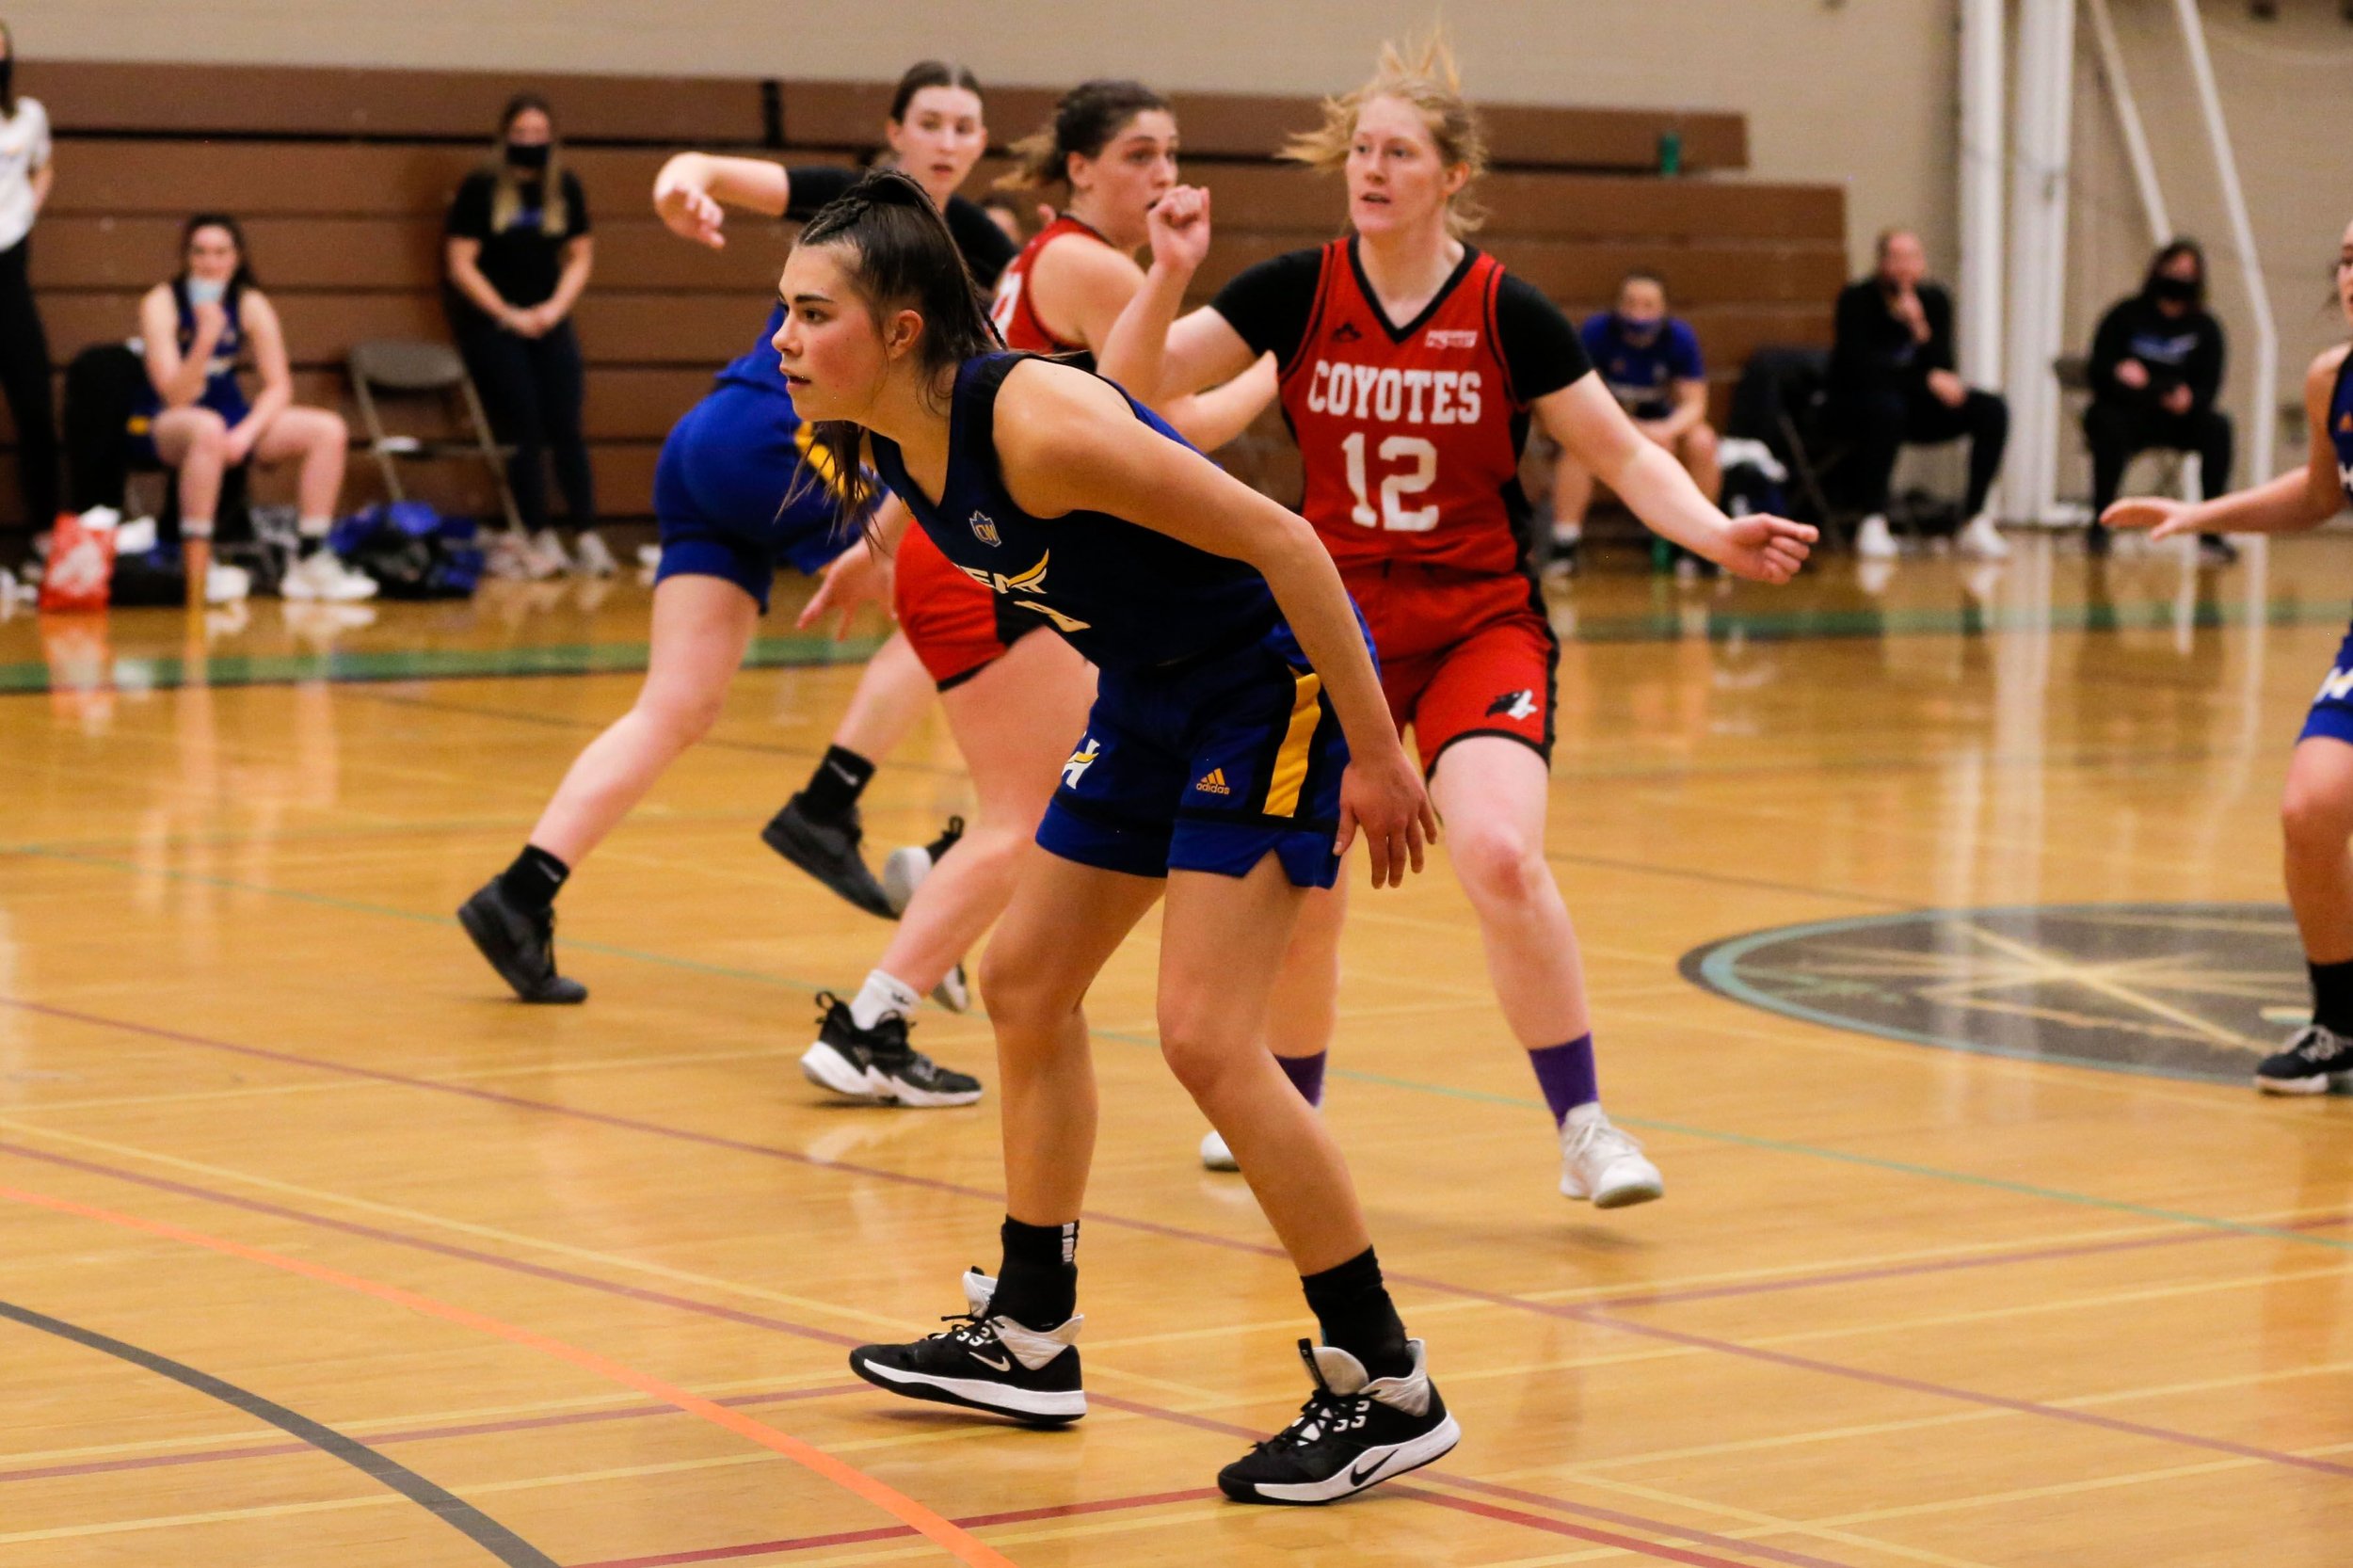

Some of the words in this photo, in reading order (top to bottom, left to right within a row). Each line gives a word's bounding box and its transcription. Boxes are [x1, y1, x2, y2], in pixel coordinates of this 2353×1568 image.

[1307, 359, 1482, 424] COYOTES
[1341, 431, 1440, 532] 12
[1196, 782, 1230, 795] adidas
